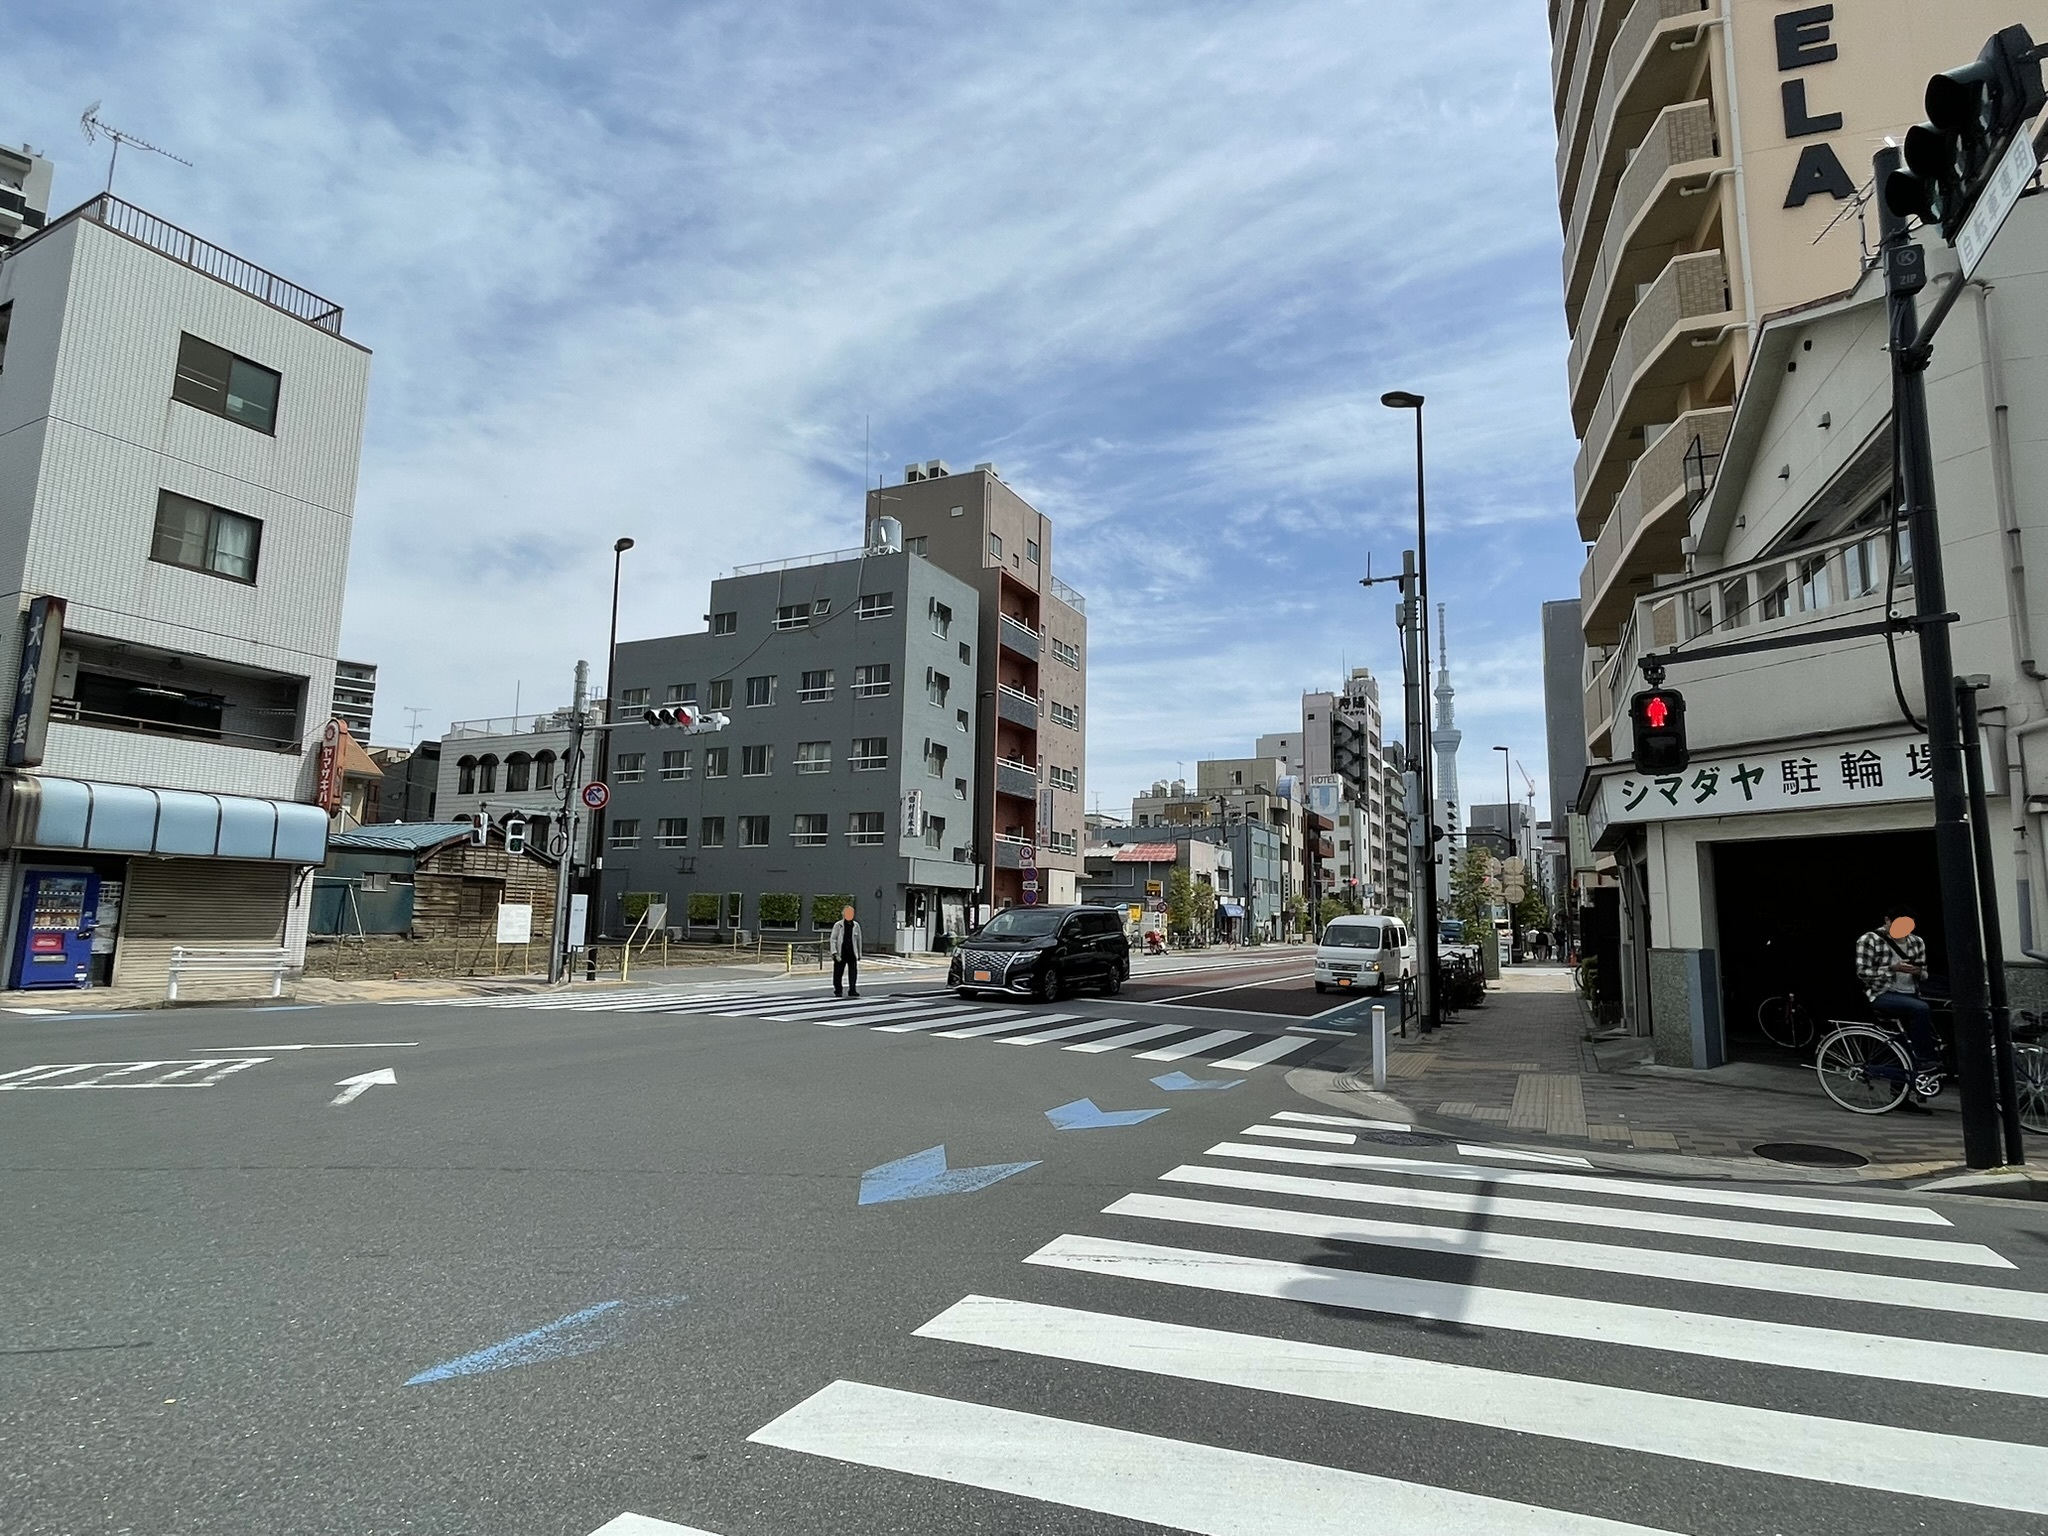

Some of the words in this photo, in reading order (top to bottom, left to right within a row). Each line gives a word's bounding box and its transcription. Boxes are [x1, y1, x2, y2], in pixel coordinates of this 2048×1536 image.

[1962, 139, 2029, 264] 自転車専用
[1311, 775, 1338, 785] HOTEL
